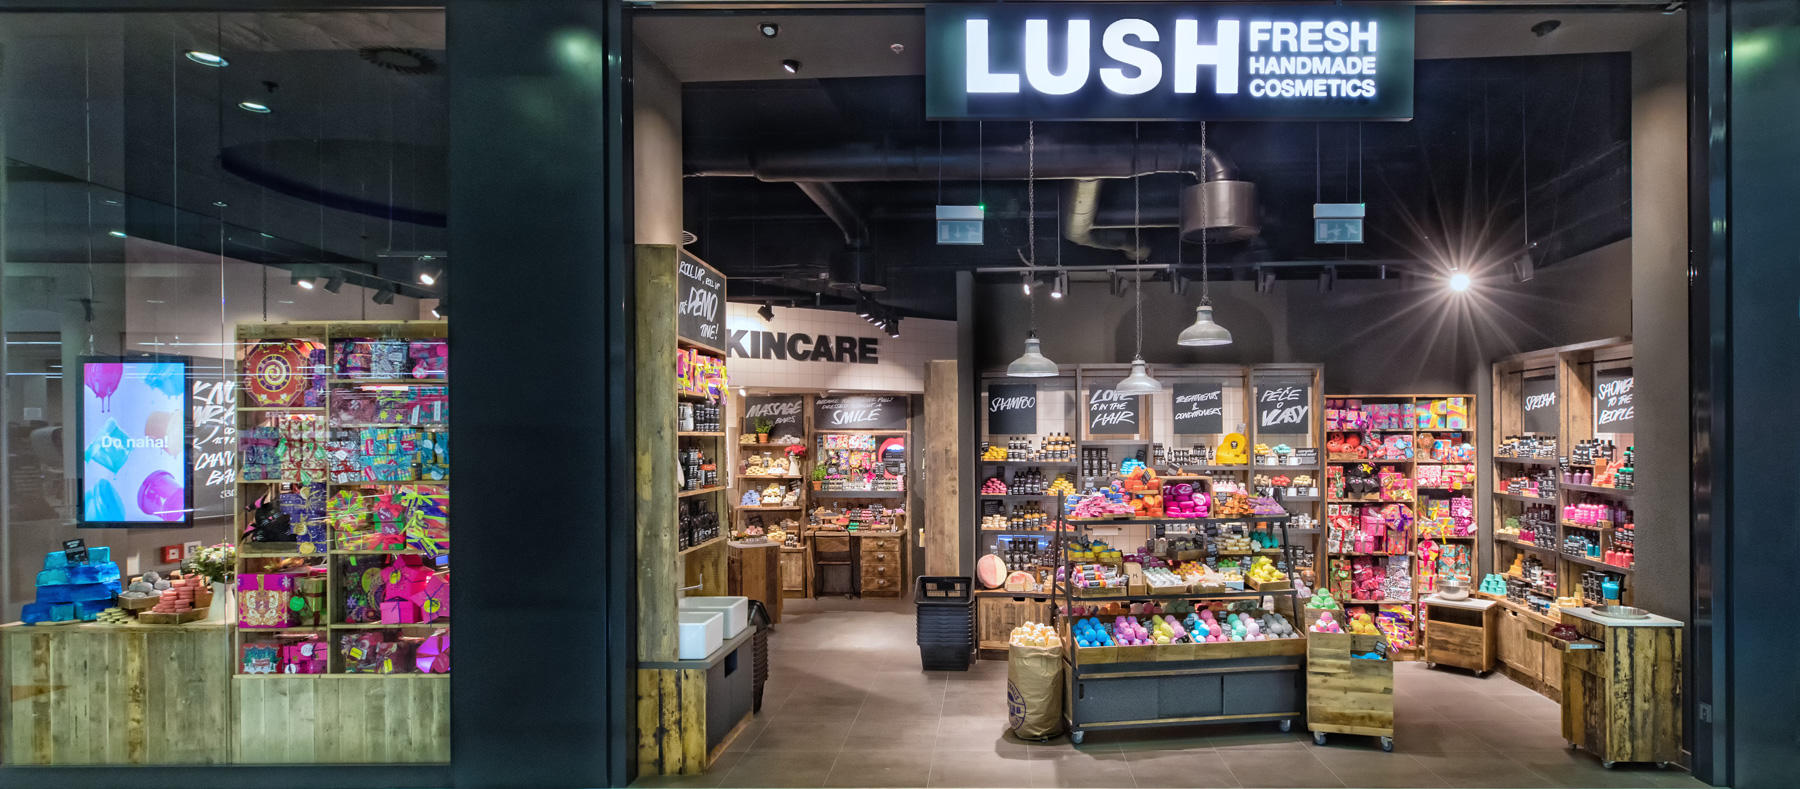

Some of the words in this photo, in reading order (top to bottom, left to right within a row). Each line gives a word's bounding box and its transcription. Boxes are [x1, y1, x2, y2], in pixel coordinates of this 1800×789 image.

[1249, 21, 1377, 52] FRESH
[966, 18, 1240, 95] LUSH
[1249, 56, 1376, 75] HANDMADE
[1249, 79, 1376, 97] COSMETICS
[687, 286, 718, 322] DEMO
[1090, 389, 1134, 404] LOVE
[1607, 397, 1617, 407] TO
[1617, 394, 1633, 406] THE
[746, 400, 802, 418] MASSAGE
[1099, 403, 1108, 411] IN
[1109, 402, 1128, 410] THE
[1598, 406, 1634, 425] PEOPLE
[831, 408, 882, 425] SMILE
[1091, 411, 1136, 428] HAIR
[1261, 405, 1309, 427] VLASY
[101, 435, 122, 448] Do
[126, 435, 169, 449] naha!
